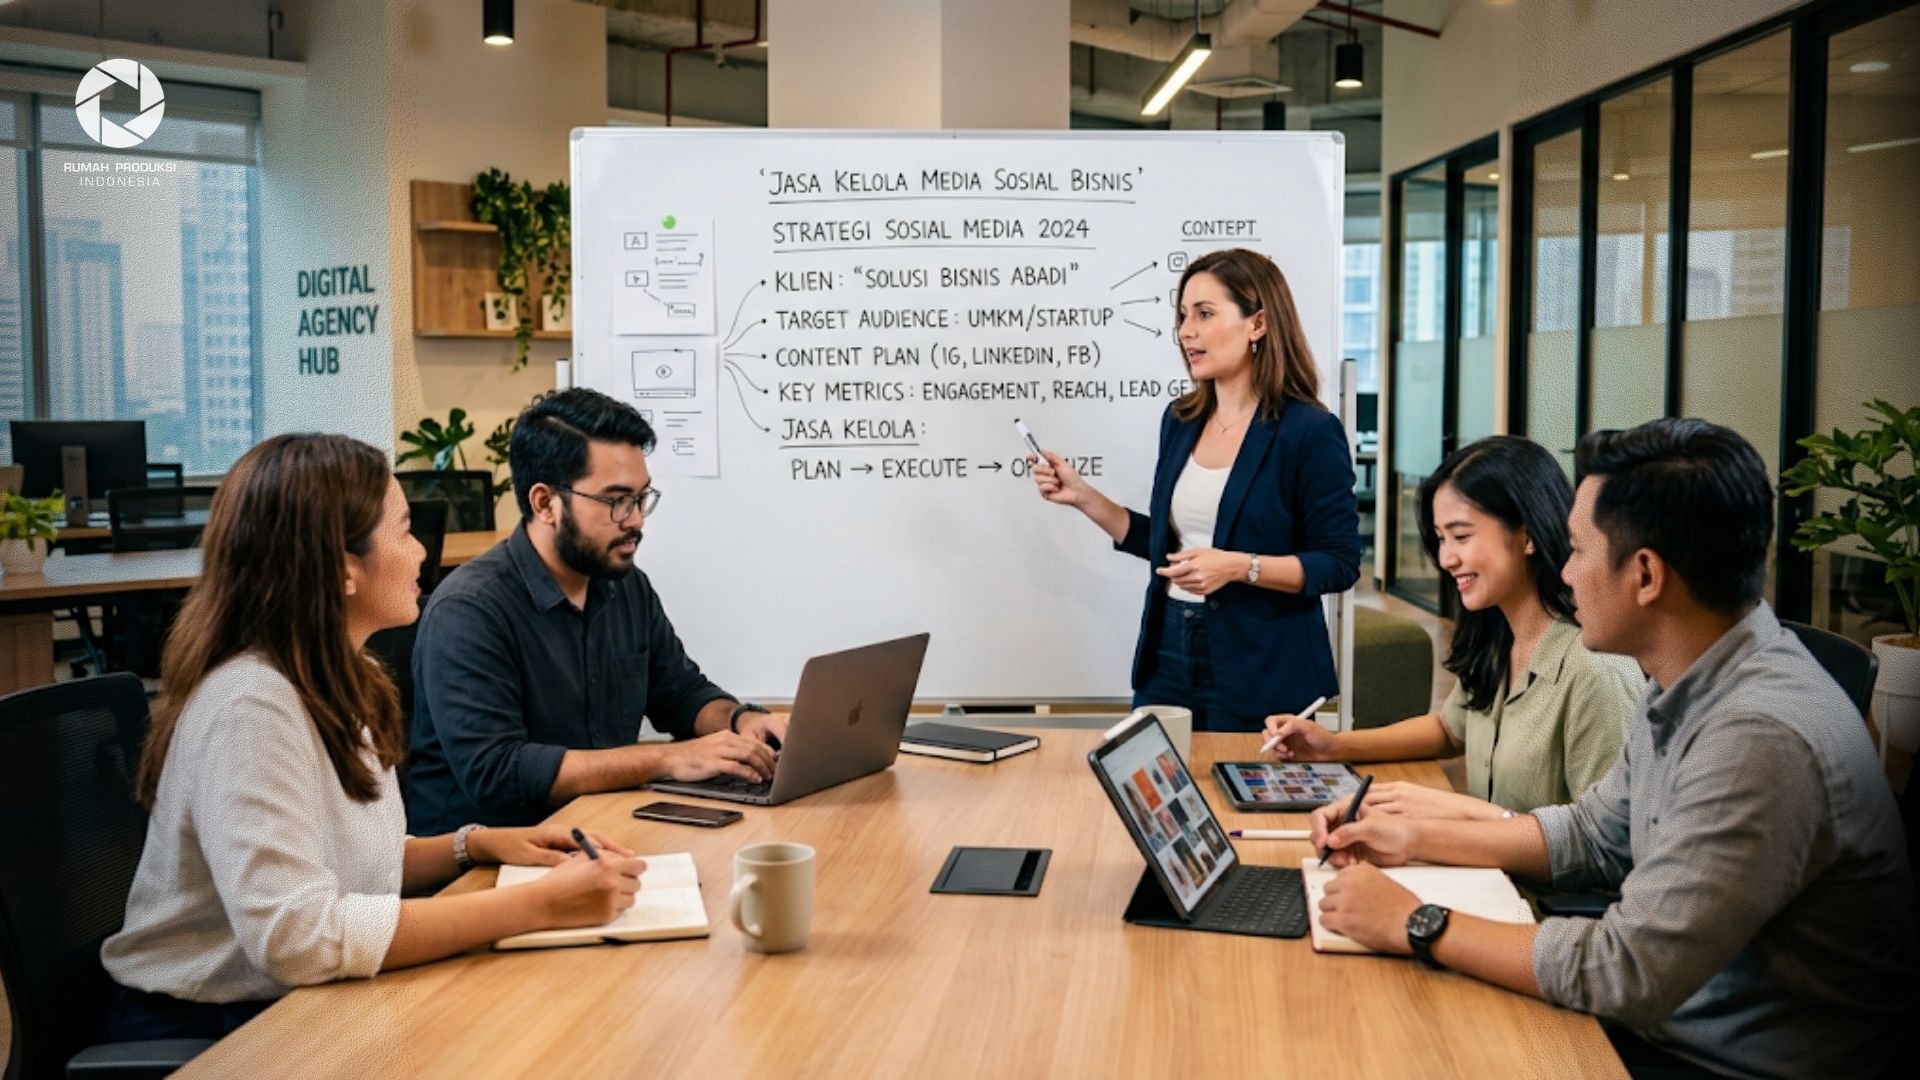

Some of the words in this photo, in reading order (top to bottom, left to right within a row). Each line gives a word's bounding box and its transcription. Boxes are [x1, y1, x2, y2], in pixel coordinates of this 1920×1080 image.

[835, 170, 909, 192] KELOLA
[921, 168, 982, 191] MEDIA
[994, 168, 1059, 191] SOSIAL
[773, 220, 871, 243] STRATEGI
[885, 219, 953, 240] SOSIAL
[963, 219, 1025, 239] MEDIA
[1038, 218, 1091, 239] 2024
[1181, 219, 1257, 236] CONTEPT
[297, 264, 375, 297] DIGITAL
[941, 266, 1001, 287] BISNIS
[298, 304, 379, 336] AGENCY
[775, 309, 849, 330] TARGET
[967, 305, 1115, 332] UMKM/STARTUP
[299, 346, 340, 374] HUB
[776, 346, 863, 368] CONTENT
[873, 346, 920, 366] PLAN
[1066, 344, 1101, 369] FB)
[779, 382, 816, 403] KEY
[922, 380, 1047, 404] ENGAGEMENT,
[1053, 379, 1114, 402] REACH,
[1119, 379, 1162, 398] LEAD
[781, 418, 833, 441] JASA
[792, 458, 842, 480] PLAN
[881, 458, 968, 479] EXECUTE
